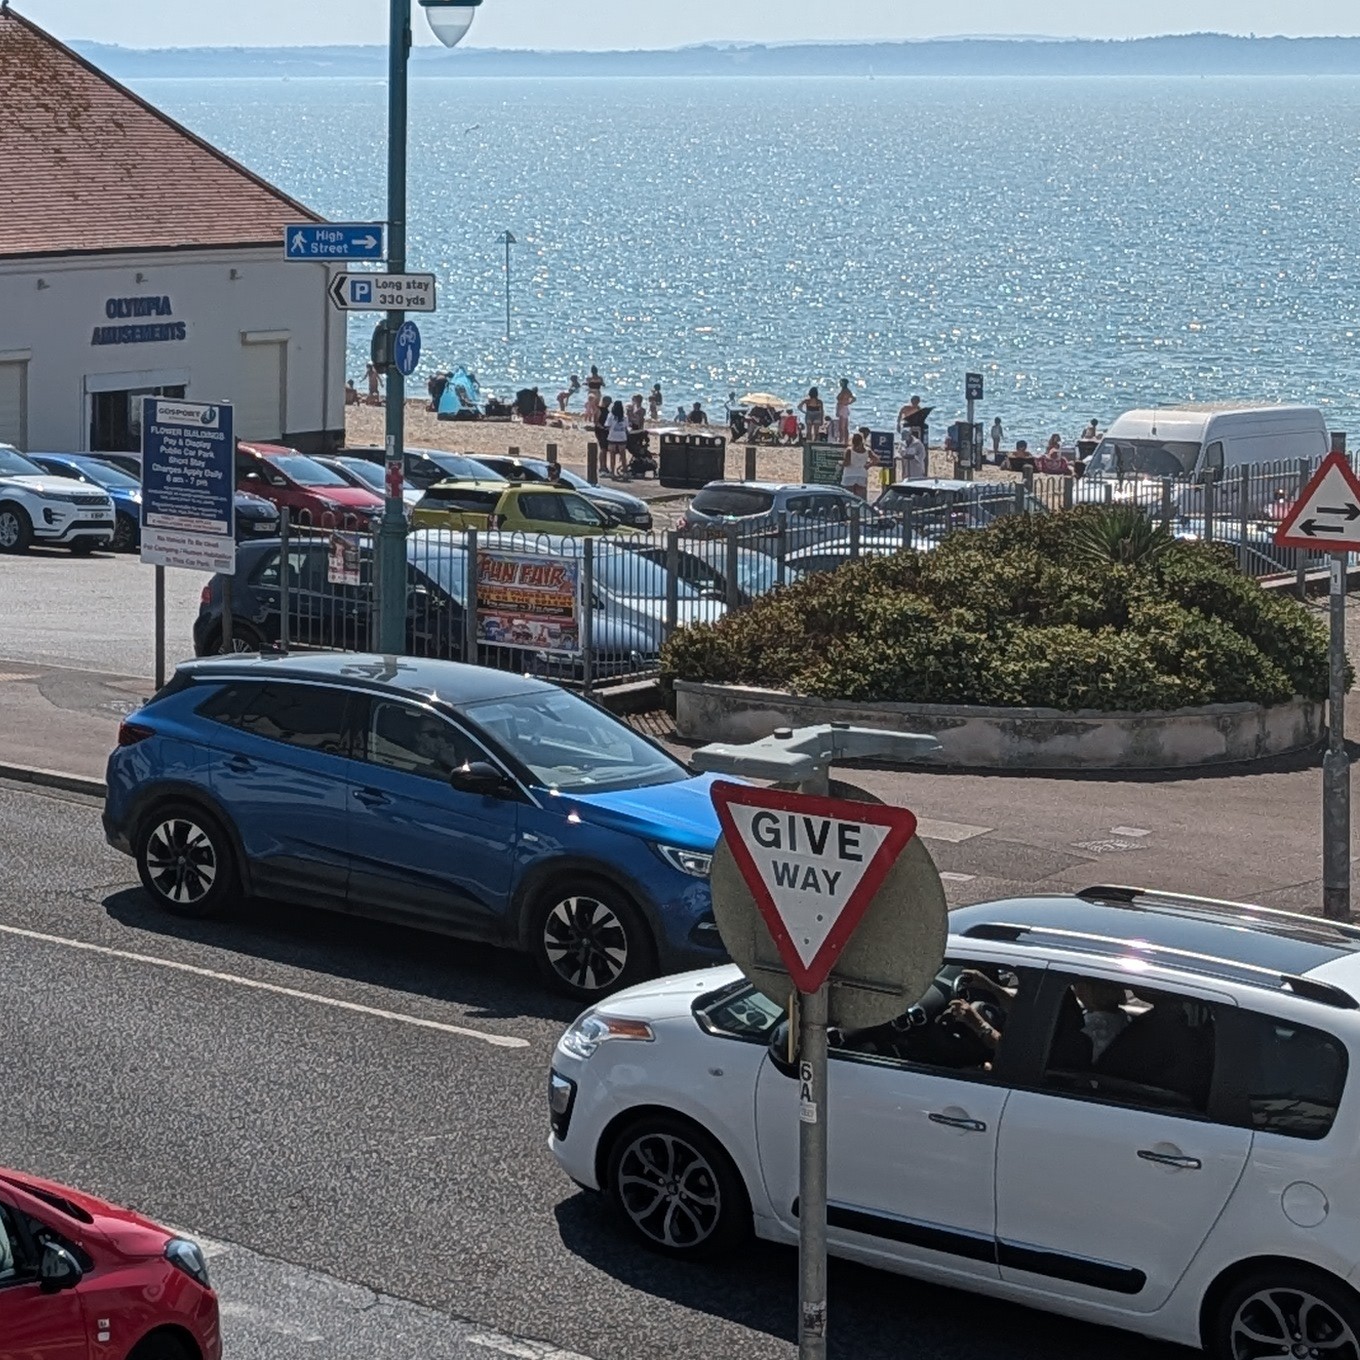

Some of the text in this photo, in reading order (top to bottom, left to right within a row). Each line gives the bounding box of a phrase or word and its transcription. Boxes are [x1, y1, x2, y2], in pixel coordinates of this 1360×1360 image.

[316, 230, 343, 242] High
[311, 243, 348, 254] Street
[355, 283, 370, 300] P
[375, 279, 429, 291] Long stay
[105, 296, 172, 319] OLYMPIA
[380, 294, 426, 308] 330 yds
[91, 322, 186, 345] AMUSEMENTS
[158, 408, 201, 417] GOSPORT
[150, 425, 225, 440] FLOWER BUILDINGS
[163, 436, 177, 446] Pay
[184, 439, 211, 450] Display
[160, 445, 215, 459] Public Car Park
[151, 463, 223, 480] Charges Apply Daily
[480, 557, 566, 587] FUN FAIR
[751, 811, 863, 862] GIVE
[771, 859, 842, 896] WAY
[801, 1062, 812, 1082] 6
[800, 1082, 811, 1102] A
